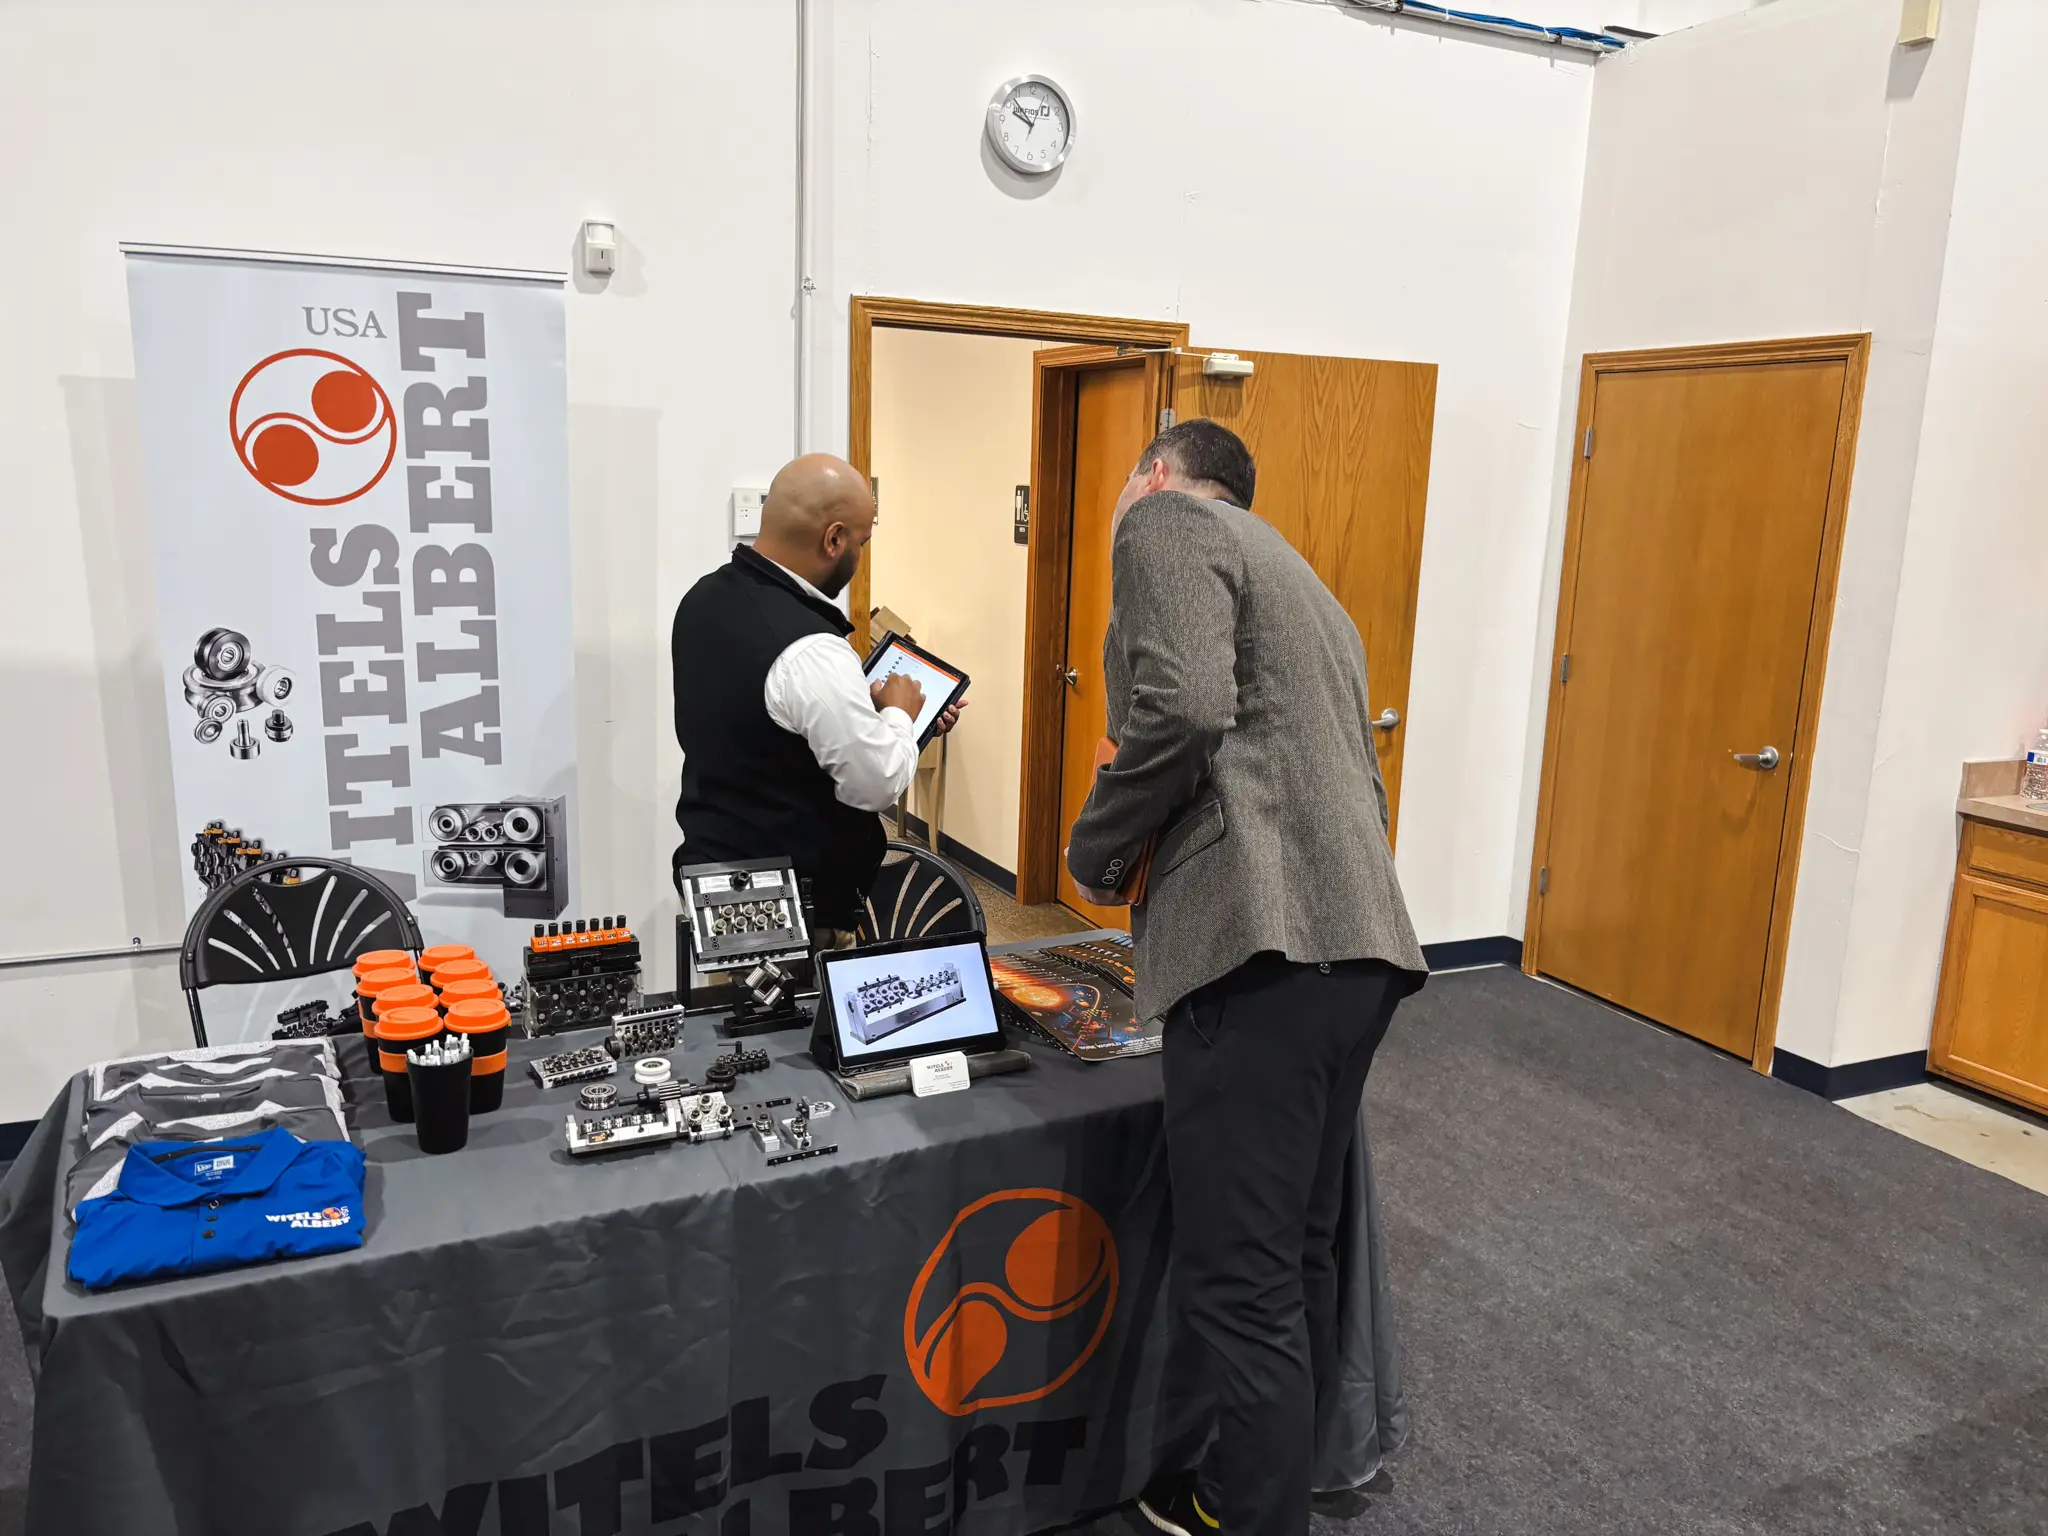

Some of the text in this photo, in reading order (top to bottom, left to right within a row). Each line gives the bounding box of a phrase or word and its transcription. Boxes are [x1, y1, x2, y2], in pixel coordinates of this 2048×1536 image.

[1028, 84, 1037, 95] 12
[1054, 106, 1060, 117] 2
[999, 114, 1006, 124] 9
[1057, 123, 1063, 132] 3
[1003, 132, 1009, 142] 8
[1050, 140, 1056, 148] 4
[1013, 145, 1020, 155] 7
[1040, 149, 1047, 159] 5
[1026, 151, 1033, 161] 6
[301, 305, 387, 339] USA
[396, 290, 502, 765] ALBERT
[309, 522, 418, 925] ITELS
[265, 1212, 321, 1222] WITELS
[290, 1216, 351, 1228] ALBERT
[676, 1415, 1088, 1536] BERT
